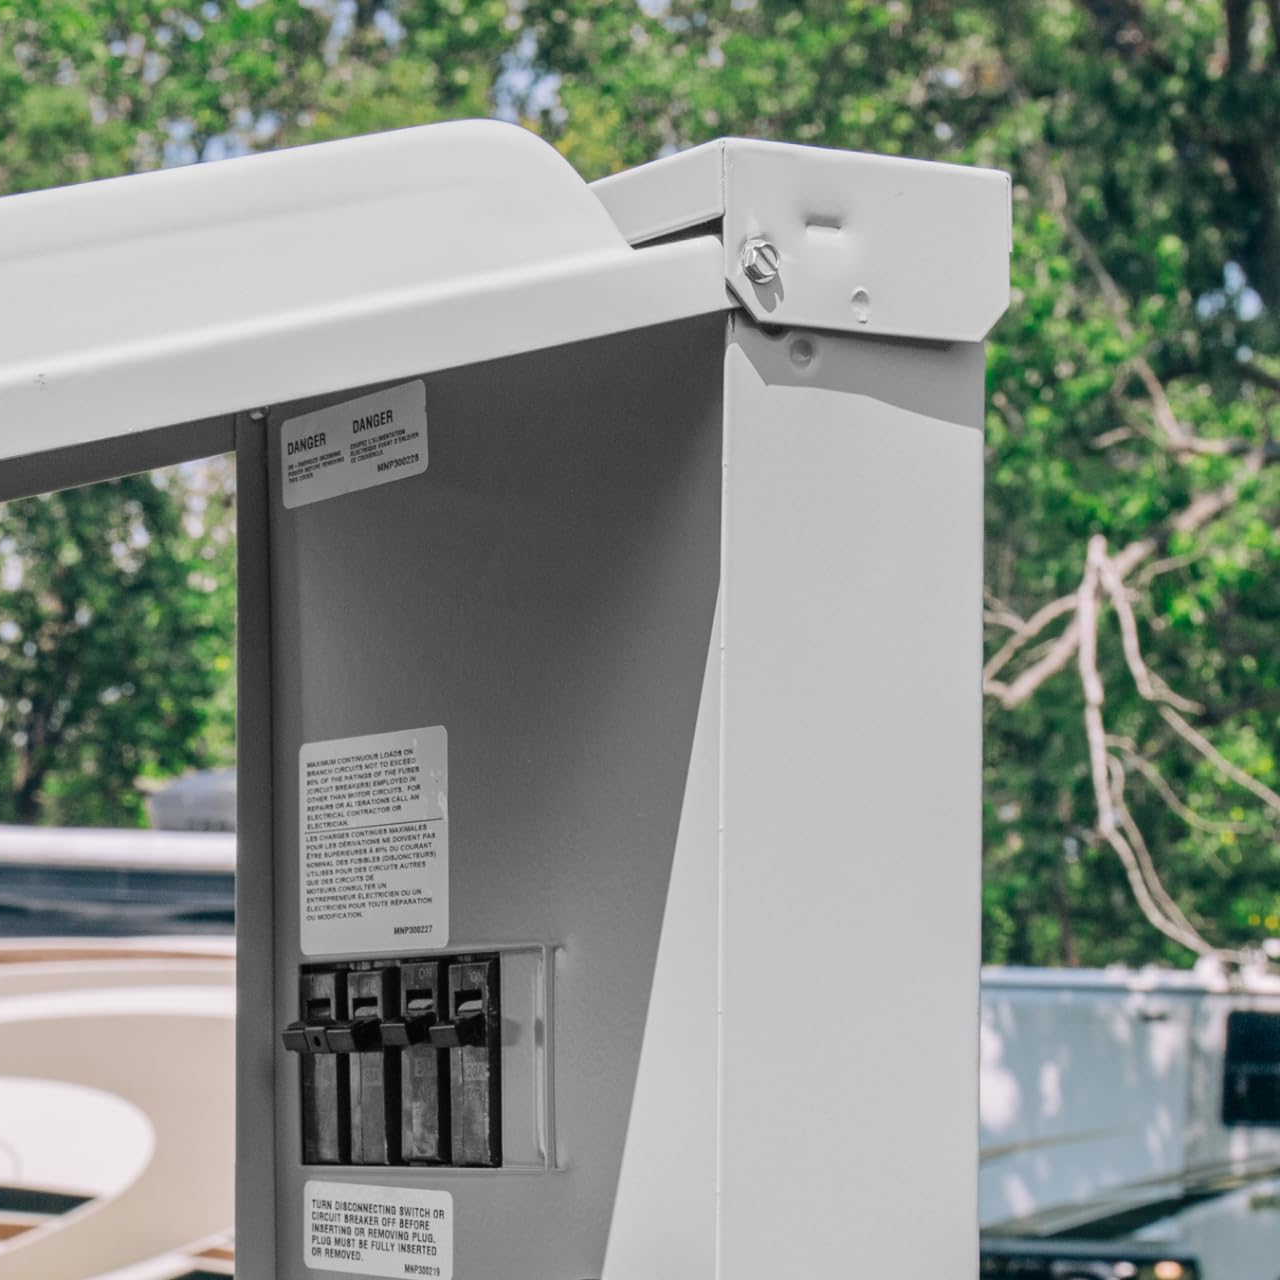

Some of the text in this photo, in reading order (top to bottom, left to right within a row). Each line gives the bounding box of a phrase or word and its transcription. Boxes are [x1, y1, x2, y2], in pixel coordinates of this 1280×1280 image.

[353, 410, 392, 433] DANGER
[288, 433, 326, 455] DANGER
[307, 759, 336, 768] MAXIMUM
[338, 754, 378, 764] CONTINUOUS
[380, 750, 402, 759] LOADS
[307, 768, 333, 777] BRANCH
[334, 764, 363, 773] CIRCUITS
[390, 758, 416, 766] EXCEED
[345, 772, 372, 780] RATINGS
[399, 766, 419, 774] FUSES
[373, 777, 408, 787] EMPLOYED
[307, 795, 328, 803] OTHER
[348, 790, 370, 799] MOTOR
[307, 804, 333, 812] REPAIRS
[346, 798, 390, 808] ALTERATIONS
[308, 812, 345, 821] ELECTRICAL
[347, 807, 390, 817] CONTRACTOR
[319, 832, 349, 840] CHARGES
[351, 828, 387, 838] CONTINUES
[389, 824, 427, 835] MAXIMALES
[307, 843, 323, 851] POUR
[393, 834, 420, 843] DOIVENT
[401, 842, 432, 851] COURANT
[307, 860, 333, 868] NOMINAL
[350, 856, 380, 864] FUSIBLES
[369, 863, 398, 871] CIRCUITS
[400, 861, 426, 869] AUTRES
[335, 875, 364, 884] CIRCUITS
[338, 883, 376, 892] CONSULTER
[307, 894, 356, 903] ENTREPRENEUR
[394, 925, 433, 935] MNP300227
[312, 1199, 444, 1219] TURN DISCONNECTING SWITCH OR
[312, 1212, 430, 1230] CIRCUIT BREAKER OFF BEFORE
[312, 1223, 436, 1244] INSERTING OR REMOVING PLUG.
[312, 1235, 437, 1256] PLUG MUST BE FULLY INSERTED
[312, 1247, 363, 1261] OR REMOVED.
[405, 1264, 440, 1276] MNP300219
